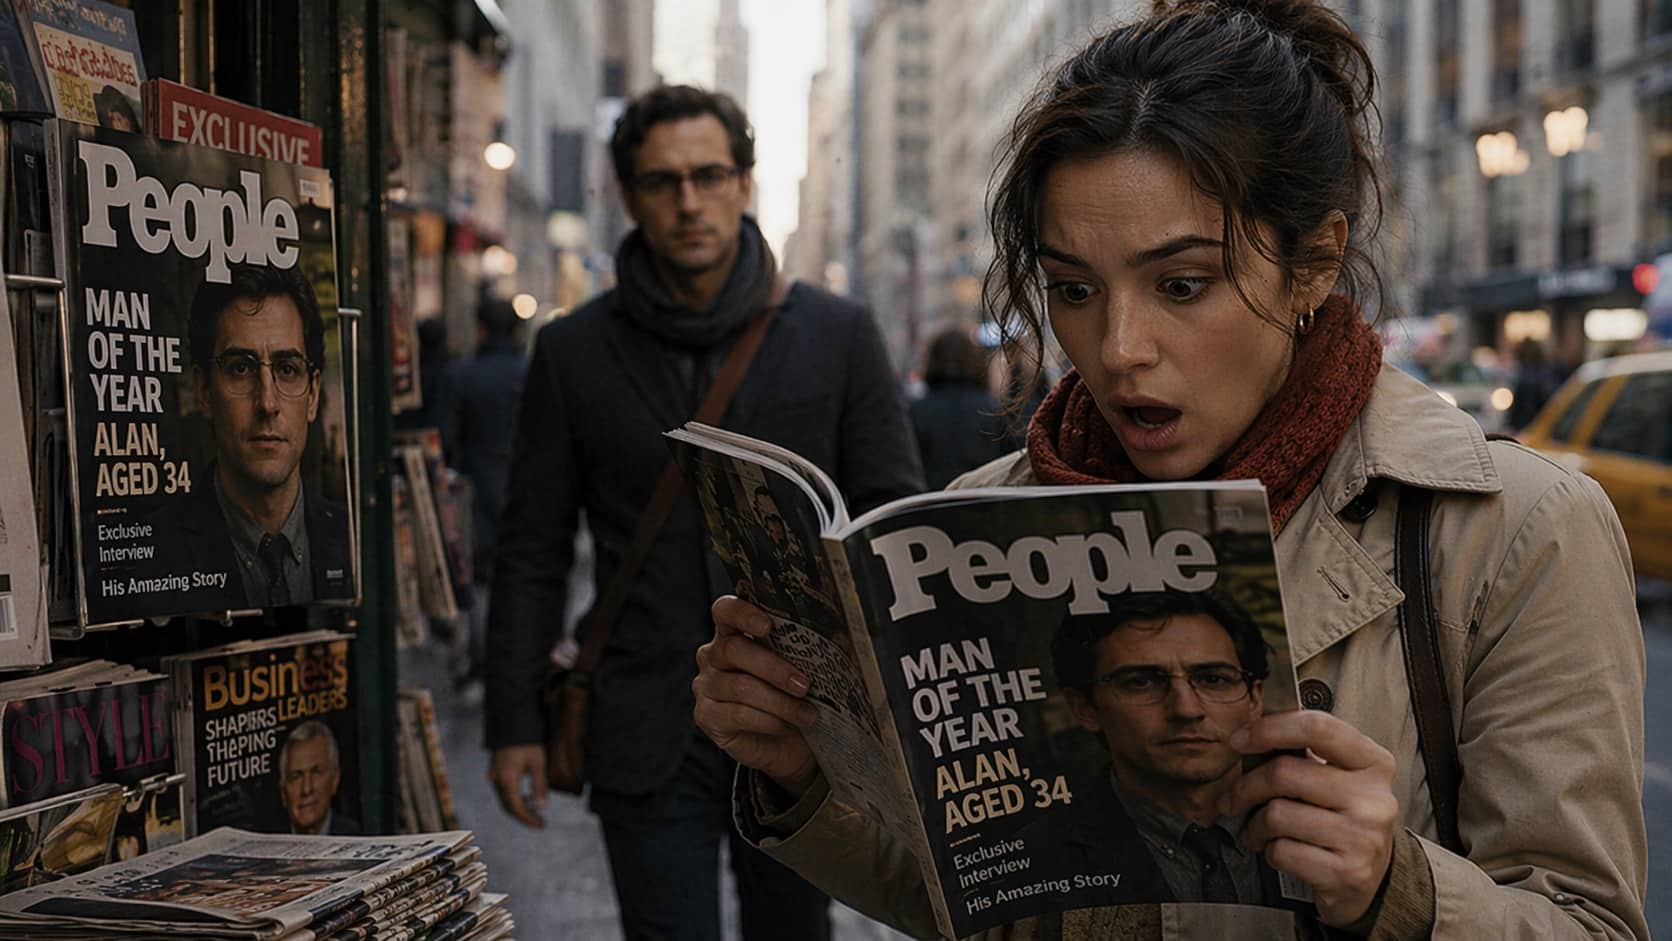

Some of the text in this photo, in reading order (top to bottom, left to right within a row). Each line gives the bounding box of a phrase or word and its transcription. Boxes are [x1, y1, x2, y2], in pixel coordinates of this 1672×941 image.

[172, 101, 310, 165] EXCLUSIVE
[78, 140, 299, 284] People
[85, 287, 151, 330] MAN
[88, 331, 182, 373] OF THE
[89, 373, 164, 413] YEAR
[94, 422, 166, 461] ALAN,
[96, 461, 192, 497] AGED 34
[98, 522, 153, 541] Exclusive
[99, 543, 155, 562] Interview
[102, 579, 126, 597] His
[192, 571, 227, 588] Story
[870, 510, 1218, 621] People
[900, 637, 995, 690] MAN
[912, 667, 1048, 723] OF THE
[12, 692, 170, 794] STYLE
[919, 707, 1025, 759] YEAR
[207, 752, 271, 788] FUTURE
[936, 747, 1031, 801] ALAN,
[945, 775, 1073, 835] AGED 34
[953, 839, 1025, 870] Exclusive
[958, 856, 1031, 889] Interview
[965, 872, 1121, 916] His Amazing Story
